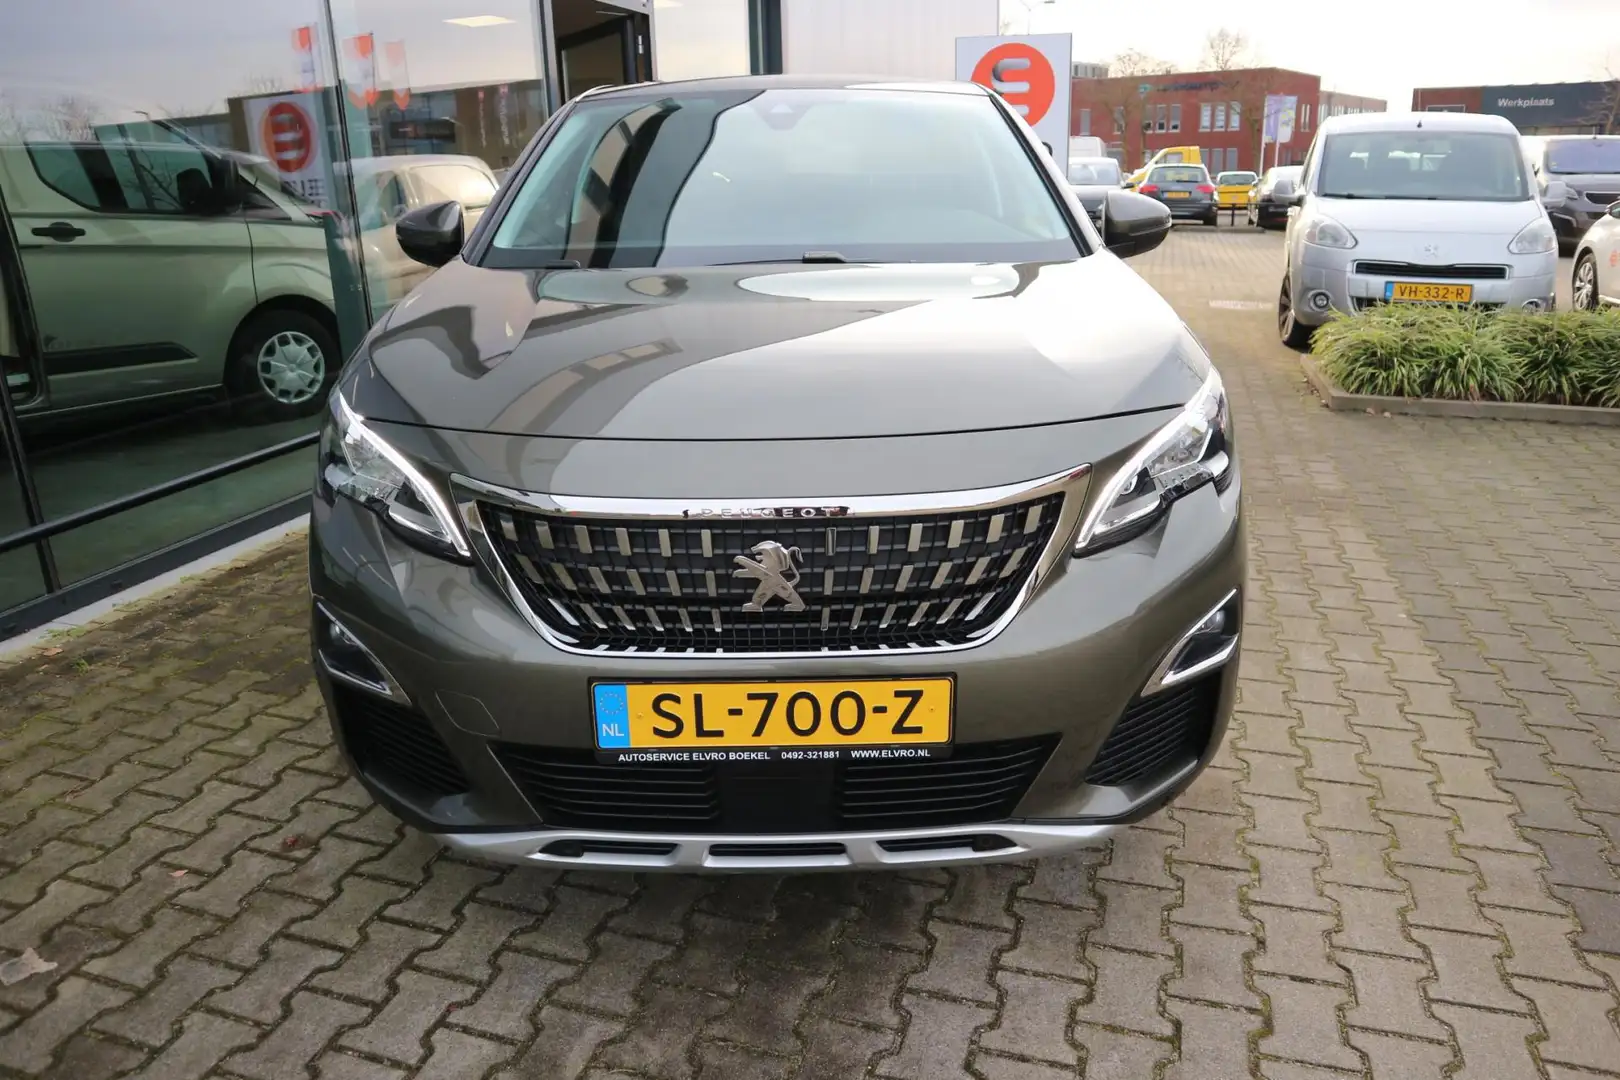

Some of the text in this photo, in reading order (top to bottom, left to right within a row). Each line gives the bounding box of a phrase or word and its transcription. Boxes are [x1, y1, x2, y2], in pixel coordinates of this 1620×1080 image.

[1498, 97, 1555, 108] Werkplaats
[1399, 285, 1464, 299] VH-332-R
[701, 506, 840, 519] PEUGEOT
[651, 689, 925, 739] SL-700-Z
[602, 723, 625, 737] NL
[618, 748, 931, 762] AUTOSERVICE ELVRO BOEKEL 0492-321881 WWW.ELVRO.NL
